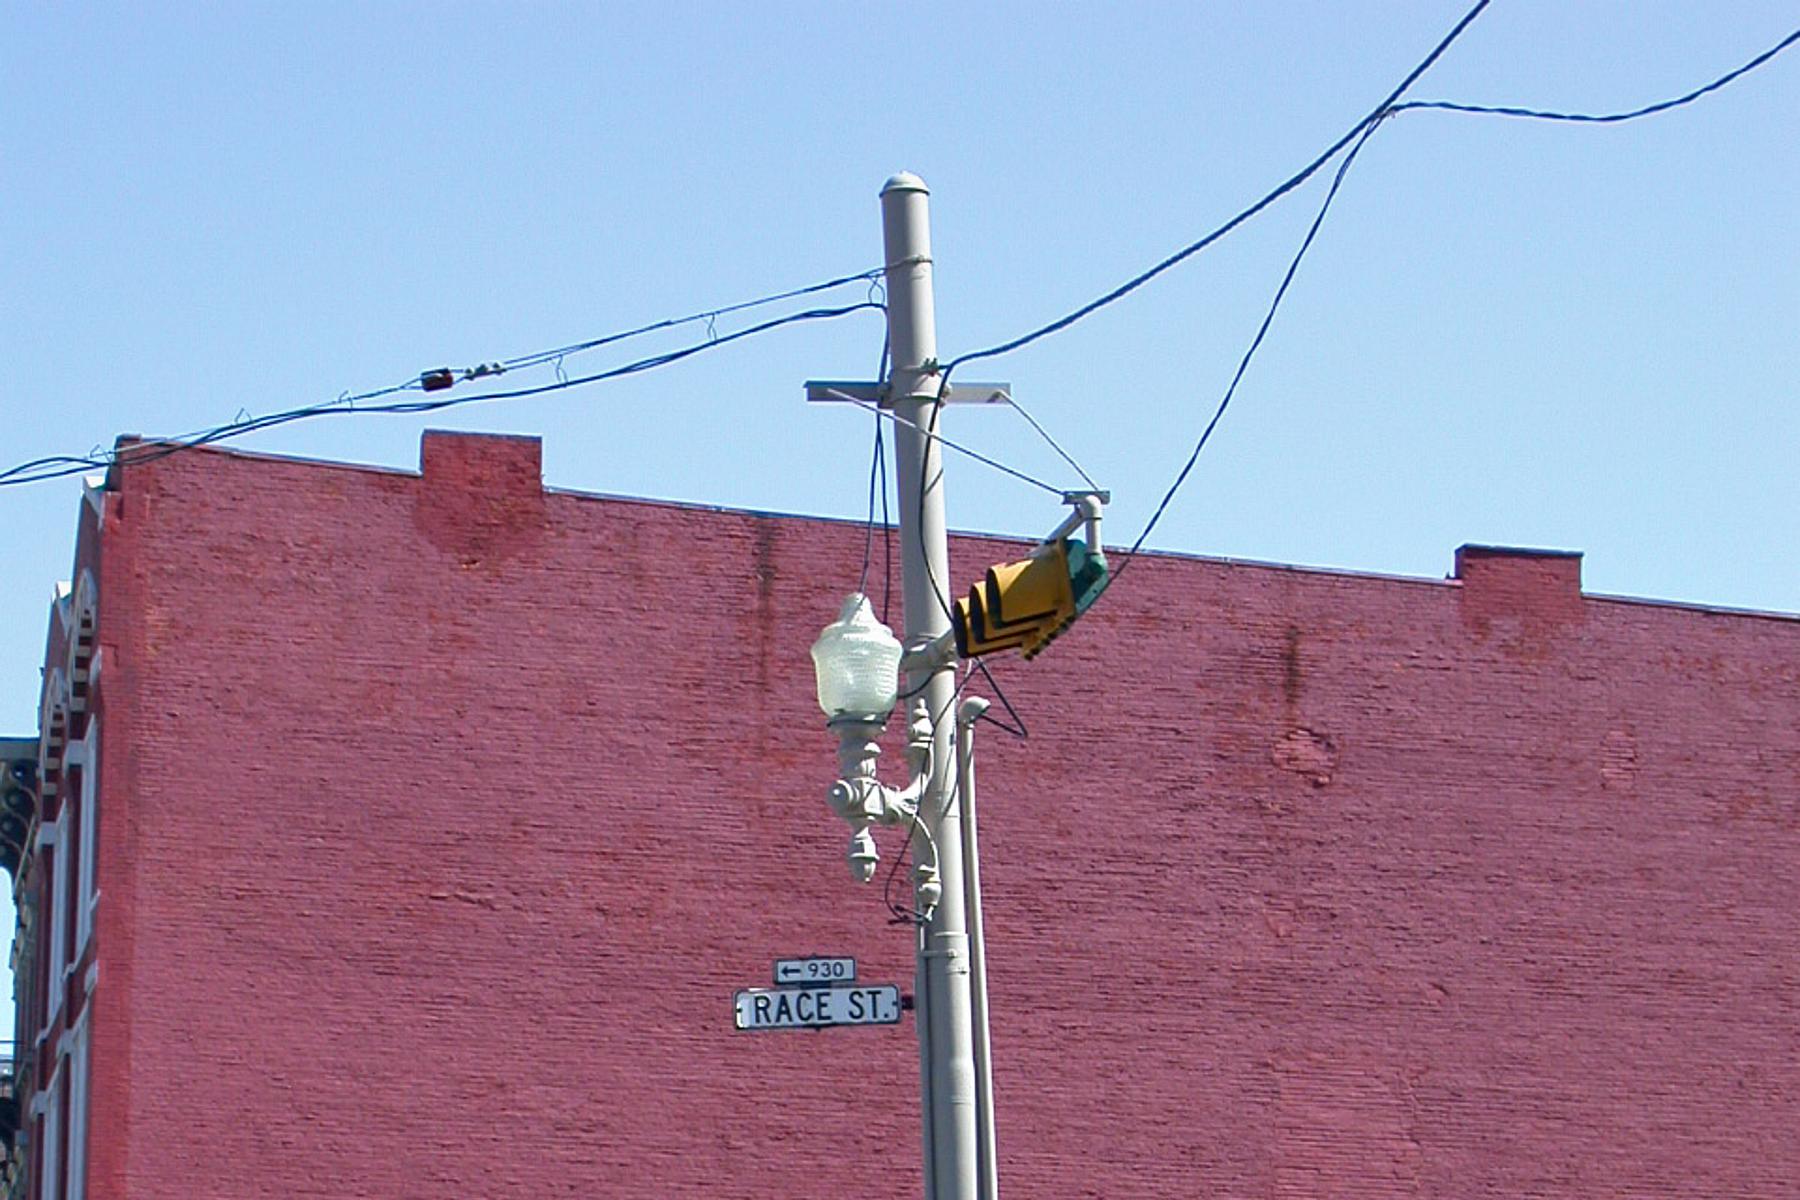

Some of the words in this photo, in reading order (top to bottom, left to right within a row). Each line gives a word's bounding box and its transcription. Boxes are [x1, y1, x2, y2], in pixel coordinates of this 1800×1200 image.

[807, 961, 844, 978] 930
[754, 992, 832, 1023] RACE
[848, 990, 889, 1019] ST.
